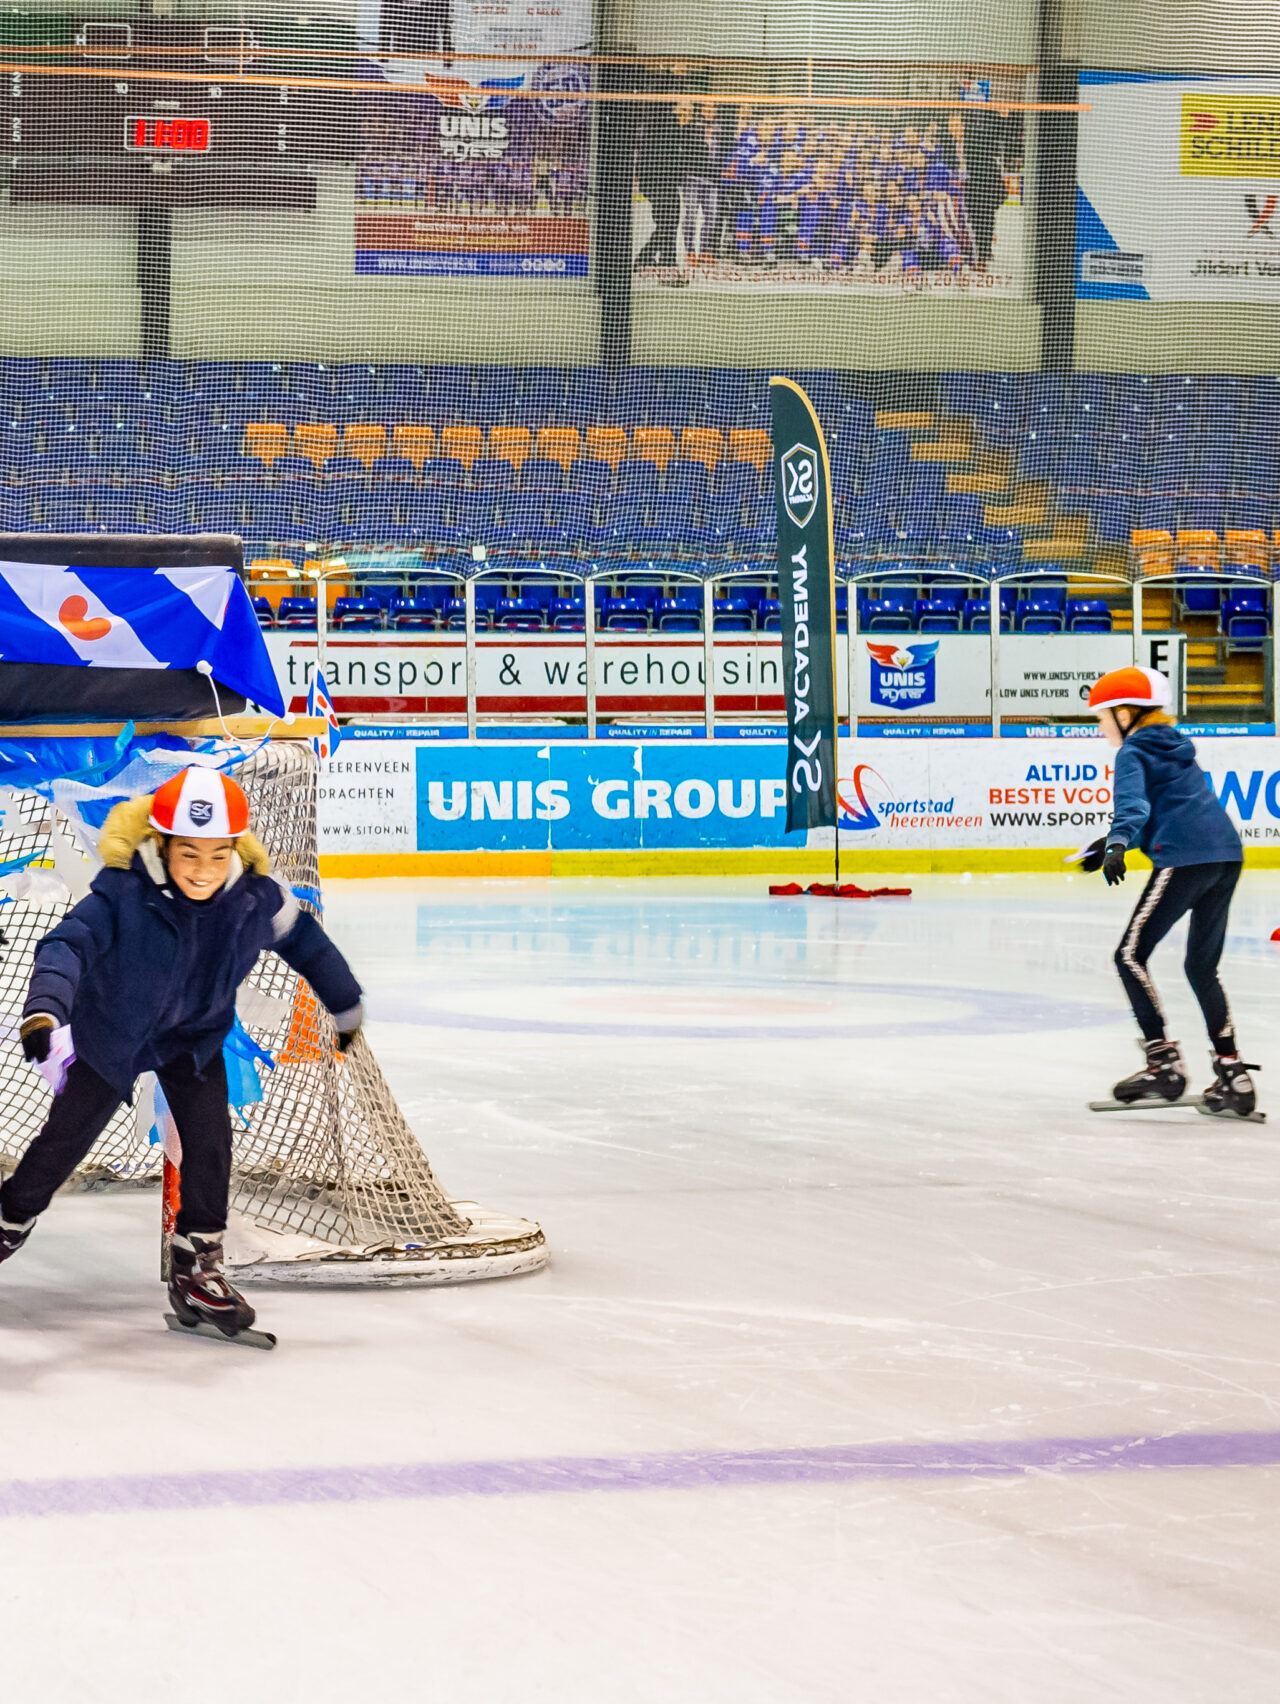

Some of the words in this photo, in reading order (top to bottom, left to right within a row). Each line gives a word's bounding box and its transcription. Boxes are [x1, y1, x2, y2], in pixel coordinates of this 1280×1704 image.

[438, 116, 508, 138] UNIS
[135, 119, 209, 150] 11:00
[287, 654, 462, 695] transpor
[499, 653, 522, 686] &
[880, 672, 926, 687] UNIS
[1019, 689, 1039, 698] UNIS
[1041, 688, 1069, 698] FLYERS
[353, 729, 395, 738] QUALITY
[608, 728, 648, 738] QUALITY
[739, 728, 778, 738] QUALITY
[882, 727, 922, 737] QUALITY
[1026, 726, 1058, 737] UNIS
[1062, 726, 1104, 737] GROU
[319, 762, 410, 774] EERENVEEN
[1025, 764, 1098, 782] ALTIJD
[319, 787, 395, 799] DRACHTEN
[428, 780, 571, 822] UNIS
[591, 778, 787, 821] GROUP
[989, 788, 1056, 805] BESTE
[1063, 788, 1111, 805] VOO
[877, 797, 955, 818] sportstad
[890, 812, 983, 829] heerenveen
[322, 823, 409, 836] WWW.SITON.NL
